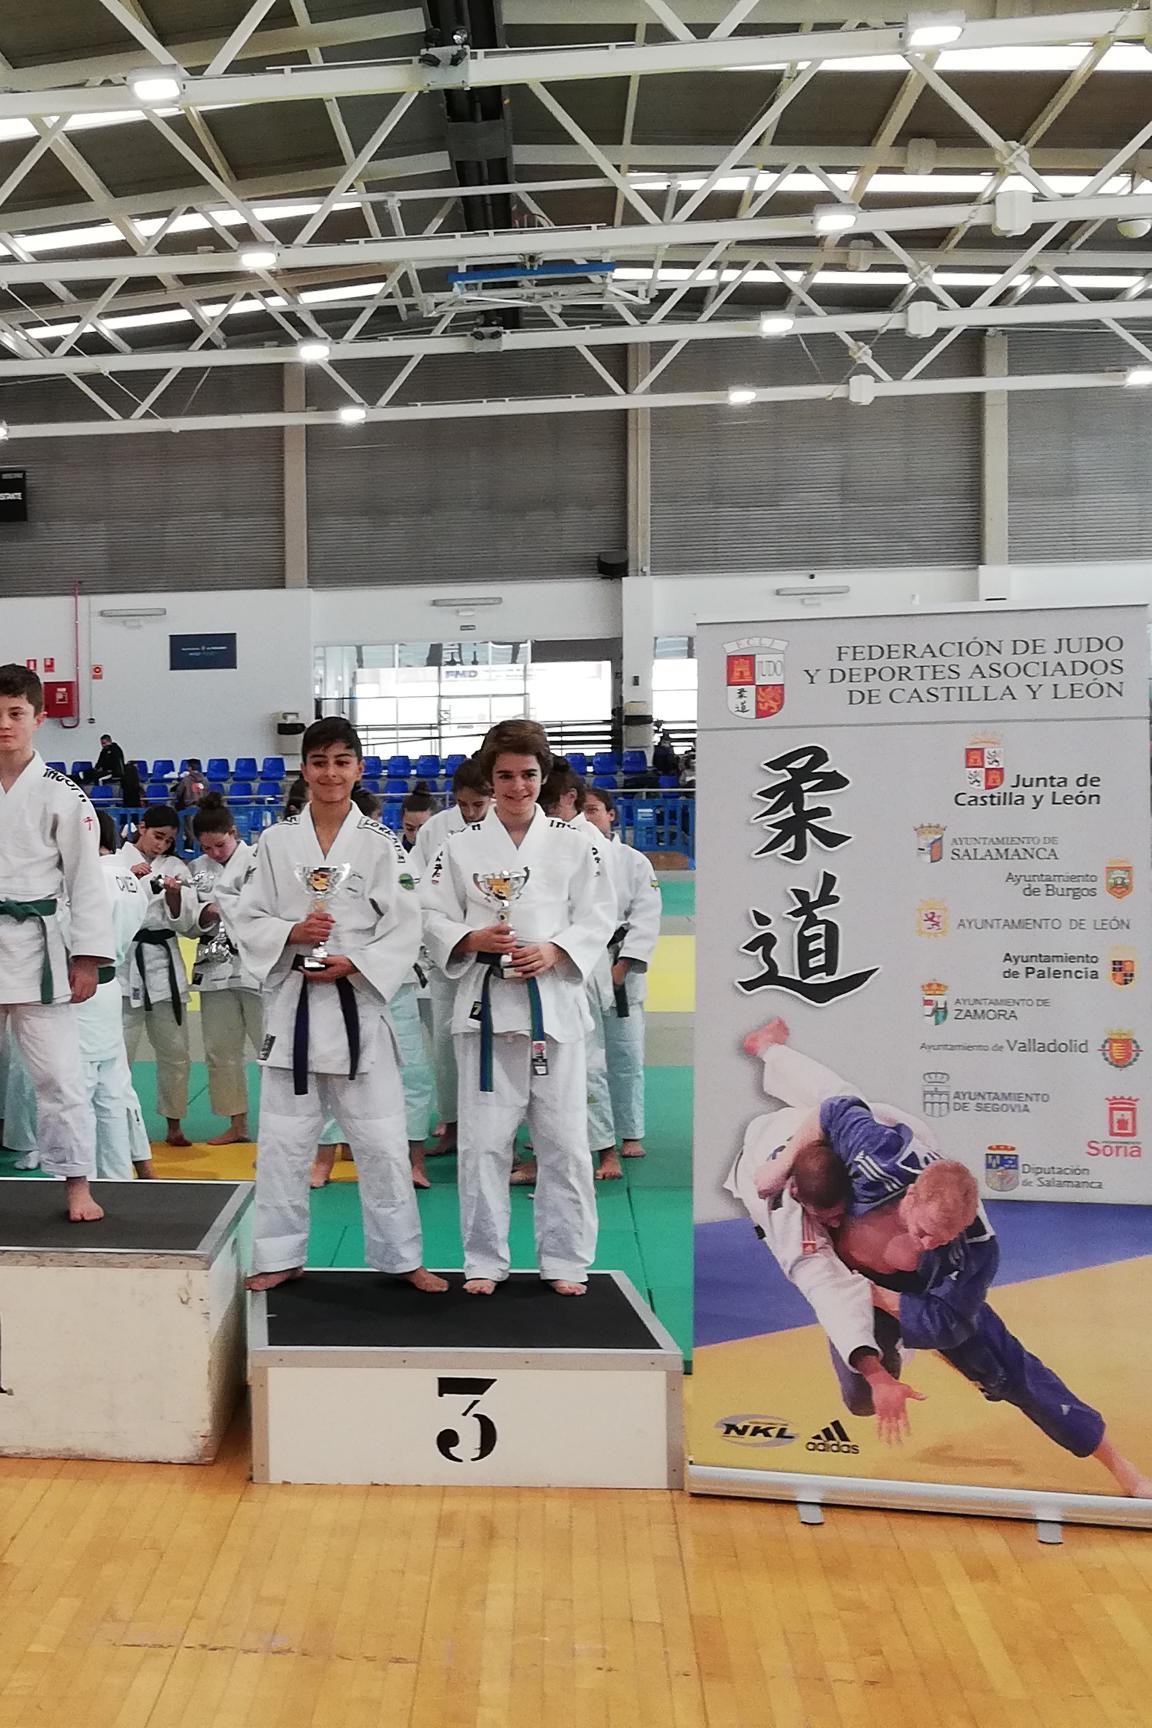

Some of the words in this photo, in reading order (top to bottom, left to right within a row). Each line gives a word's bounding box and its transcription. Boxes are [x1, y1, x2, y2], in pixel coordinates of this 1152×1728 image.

[836, 637, 1003, 662] FEDERACIÓN
[1011, 638, 1046, 656] DE
[1053, 635, 1124, 655] JUDO
[804, 669, 819, 685] Y
[828, 664, 961, 684] DEPORTES
[968, 659, 1124, 680] ASOCIADOS
[848, 688, 882, 706] DE
[889, 684, 1016, 705] CASTILLA
[1023, 683, 1043, 700] Y
[1051, 678, 1125, 700] LEÓN
[1010, 773, 1069, 789] Junta
[1076, 773, 1101, 788] de
[954, 791, 1025, 807] Castilla
[1031, 795, 1044, 810] y
[1051, 790, 1101, 806] León
[951, 836, 1040, 846] AYUNTAMIENTO
[1043, 836, 1059, 845] DE
[950, 847, 1060, 862] SALAMANCA
[1005, 872, 1098, 885] Ayuntamiento
[1023, 884, 1041, 897] de
[1046, 883, 1098, 899] Burgos
[957, 918, 1061, 931] AYUNTAMIENTO
[1069, 918, 1087, 930] DE
[1093, 914, 1131, 930] LEÓN
[1002, 952, 1099, 966] Ayuntamiento
[1002, 966, 1020, 979] de
[1024, 965, 1099, 980] Palencia
[954, 997, 1033, 1008] AYUNTAMIENTO
[1036, 997, 1051, 1007] DE
[953, 1008, 1018, 1021] ZAMORA
[920, 1041, 990, 1053] Ayuntamiento
[991, 1041, 1004, 1052] de
[1006, 1038, 1089, 1054] Valladolid
[953, 1091, 1050, 1103] AYUNTAMIENTO
[953, 1102, 969, 1112] DE
[974, 1102, 1031, 1113] SEGOVIA
[1086, 1140, 1143, 1159] Soria
[1021, 1162, 1090, 1178] Diputación
[1036, 1177, 1103, 1190] Salamanca
[436, 1376, 498, 1462] 3
[722, 1422, 796, 1439] NKL
[805, 1440, 860, 1455] adidas
